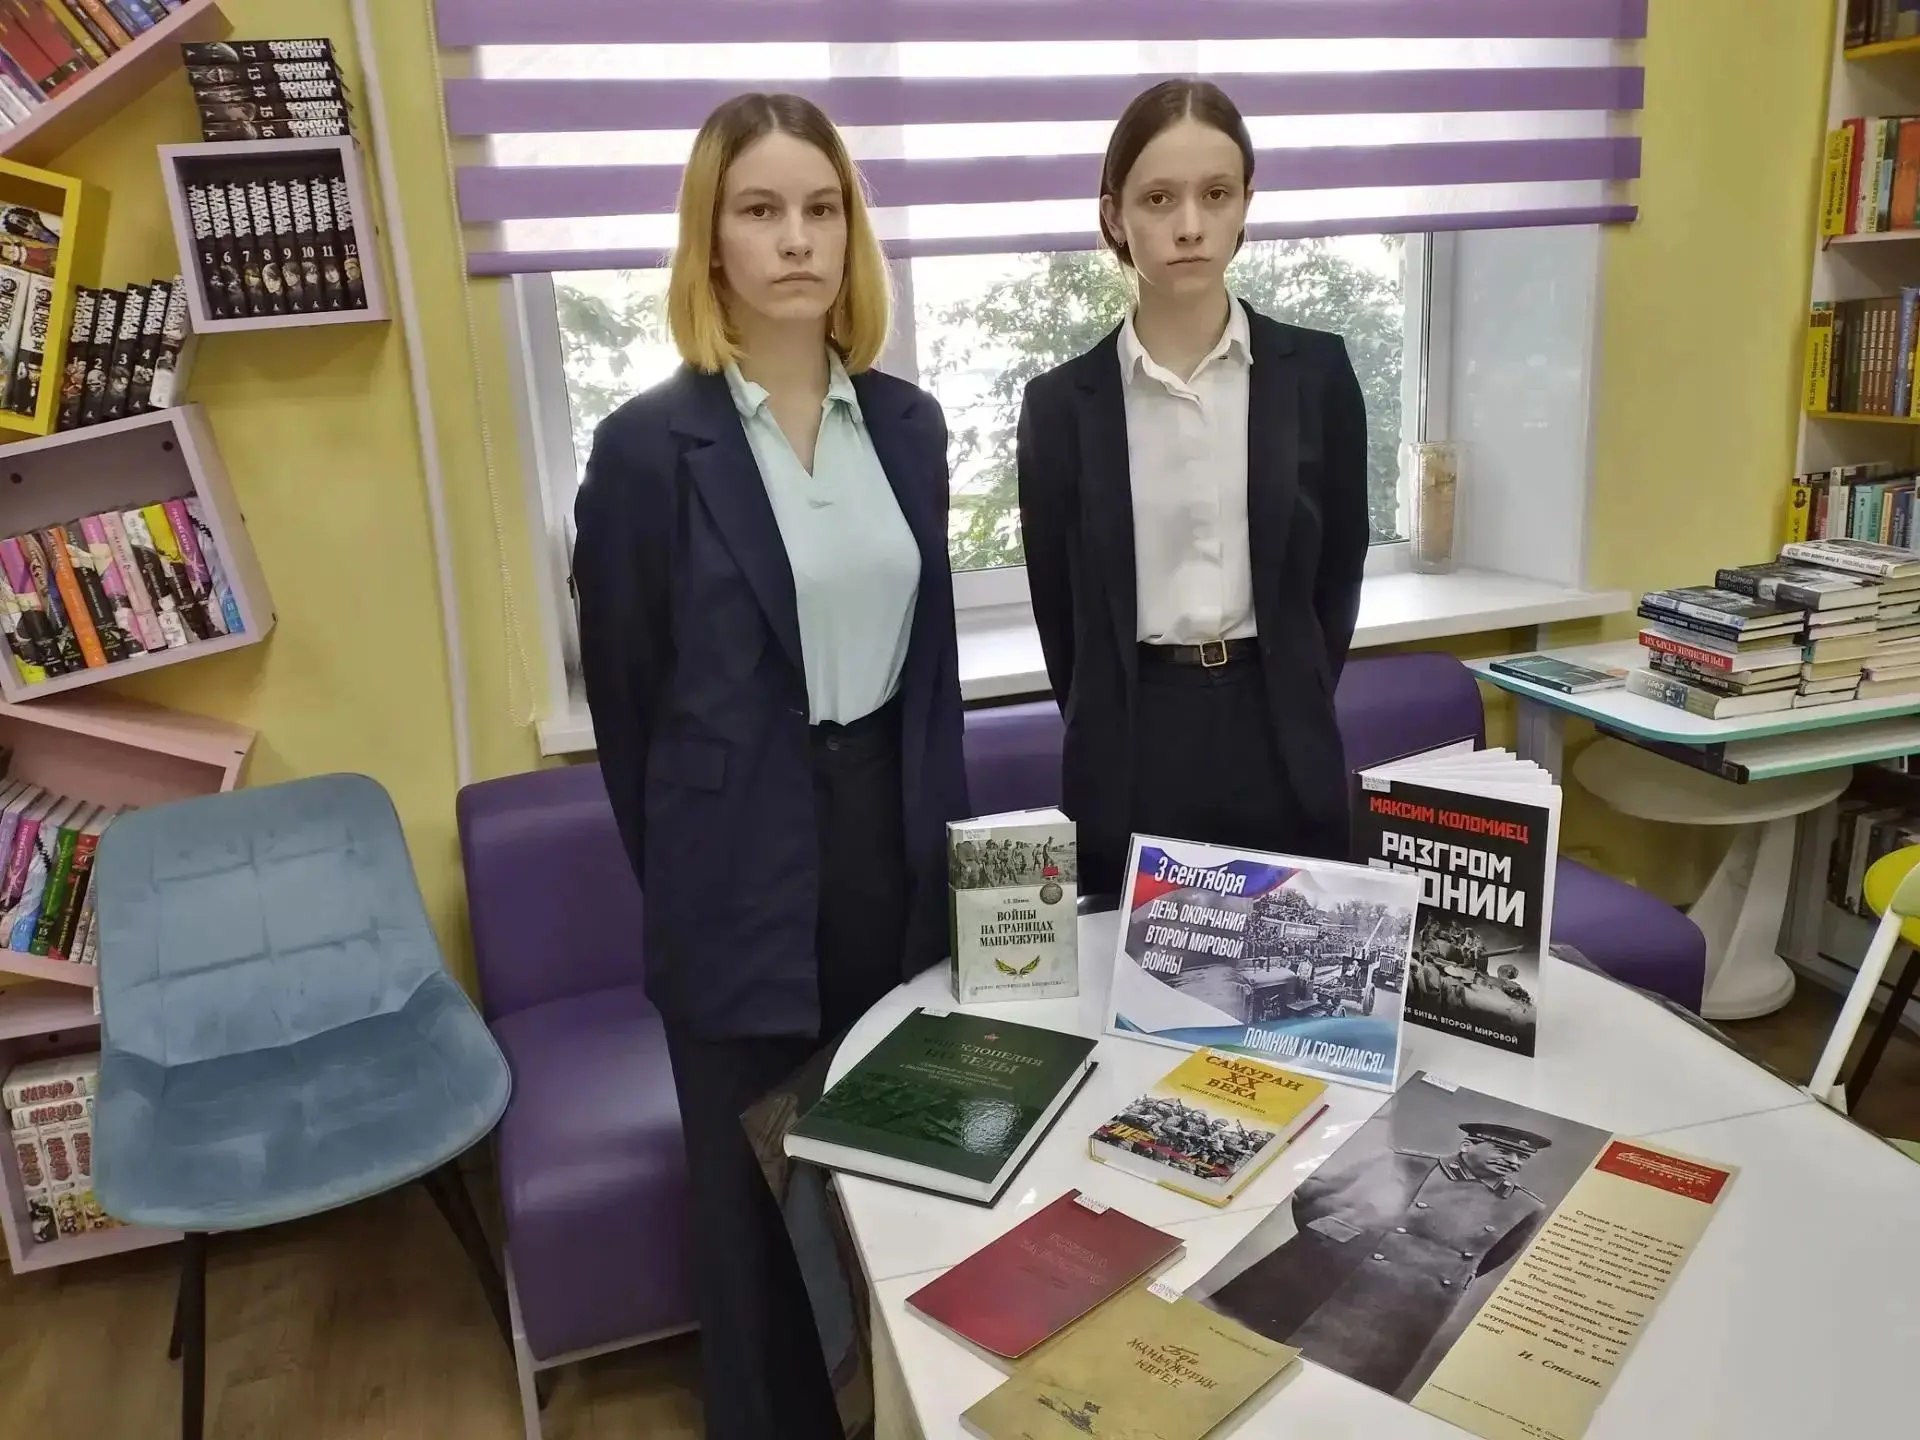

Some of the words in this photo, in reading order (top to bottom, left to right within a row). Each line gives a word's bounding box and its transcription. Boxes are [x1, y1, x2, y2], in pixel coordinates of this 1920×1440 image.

[242, 46, 256, 58] 17
[248, 68, 260, 80] 13
[253, 85, 266, 97] 14
[260, 106, 273, 118] 15
[261, 125, 275, 137] 16
[264, 250, 272, 260] 8
[284, 248, 291, 259] 9
[302, 246, 314, 258] 10
[322, 246, 334, 257] 11
[344, 244, 357, 255] 12
[206, 253, 212, 264] 5
[224, 252, 232, 262] 6
[242, 251, 250, 262] 7
[119, 354, 127, 364] 3
[142, 349, 150, 359] 4
[94, 358, 102, 368] 2
[1370, 796, 1434, 824] МАКСИМ
[1438, 810, 1528, 844] КОЛОМИЕЦ
[1382, 830, 1512, 884] РАЗГРОМ
[1154, 857, 1168, 882] 3
[1168, 865, 1247, 896] сентября
[1368, 858, 1525, 928] ОНИИ
[997, 909, 1036, 922] ВОЙНЫ
[1148, 900, 1178, 920] ДЕНЬ
[1180, 904, 1247, 932] ОКОНЧАНИЯ
[981, 925, 994, 935] НА
[999, 921, 1053, 934] ГРАНИЦАХ
[980, 932, 1056, 947] МАНЬЧЖУРИИ
[1145, 925, 1188, 950] ВТОРОЙ
[1188, 931, 1244, 959] МИРОВОЙ
[1141, 950, 1184, 975] ВОЙНЫ
[1414, 1008, 1438, 1021] БИТВА
[1440, 1016, 1472, 1031] ВТОРОЙ
[1475, 1026, 1518, 1044] МИРОВОЙ
[1244, 1027, 1298, 1057] ПОМНИМ
[1298, 1040, 1310, 1058] И
[1310, 1041, 1386, 1074] ГОРДИМСЯ!
[21, 1080, 74, 1102] NARUTO
[1205, 1078, 1257, 1100] ВЕКА
[30, 1102, 83, 1124] NARUTO
[1541, 1360, 1604, 1387] Сталин.
